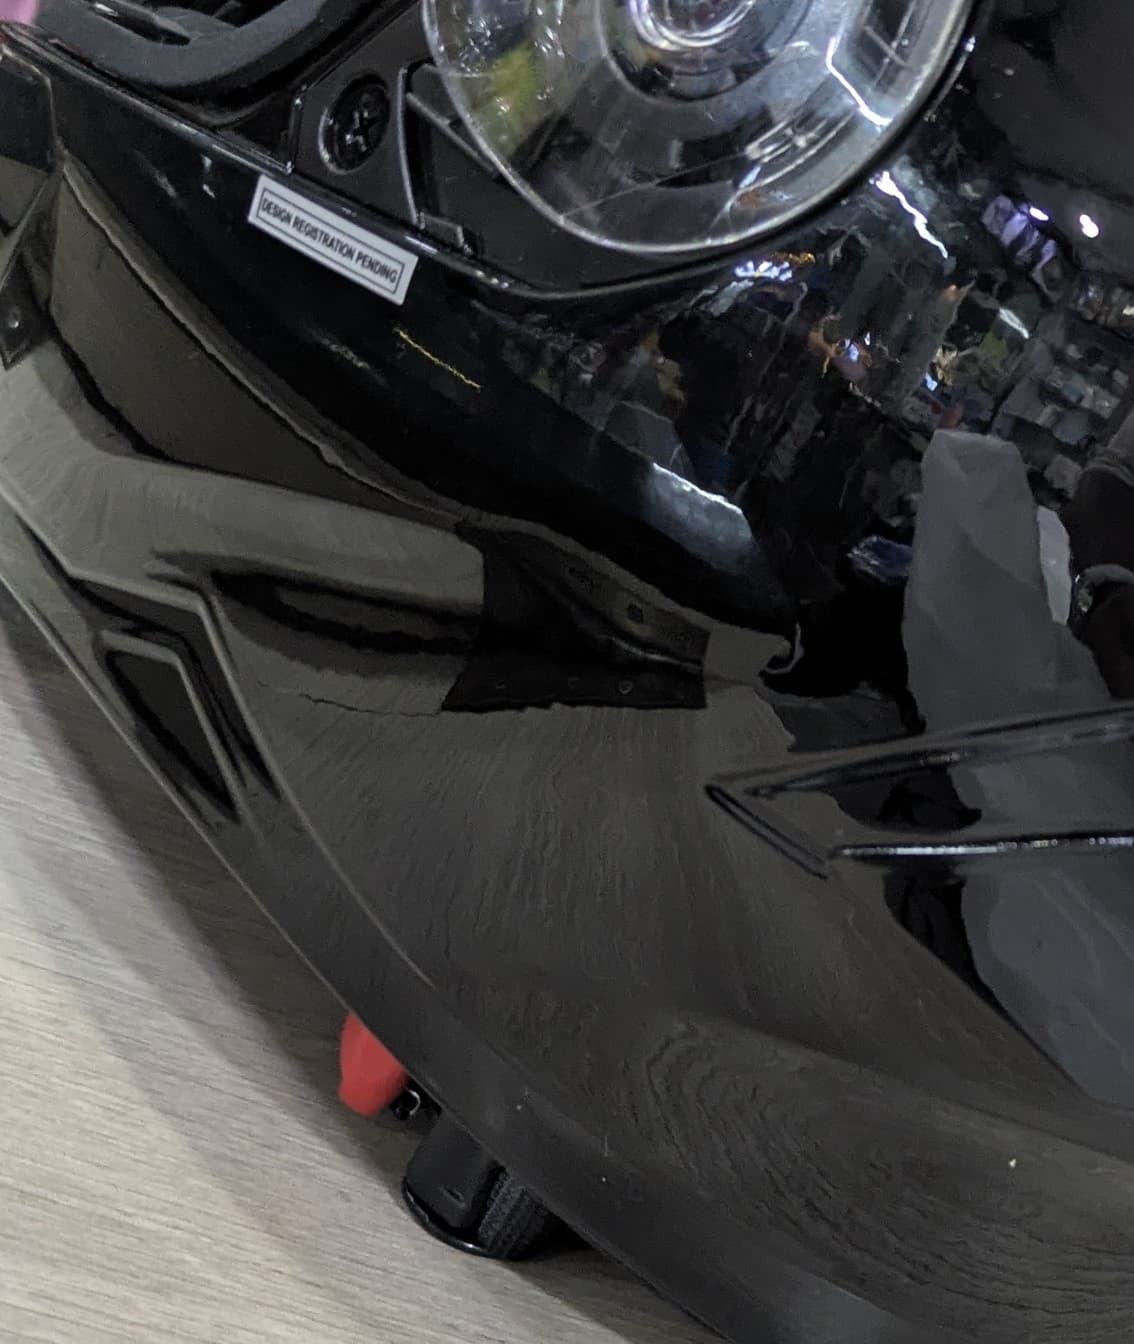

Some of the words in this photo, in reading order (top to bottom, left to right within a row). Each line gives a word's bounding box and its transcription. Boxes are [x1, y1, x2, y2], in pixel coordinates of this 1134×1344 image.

[261, 198, 293, 226] DESIGN
[292, 214, 355, 262] REGISTRATION
[355, 252, 399, 285] PENDING
